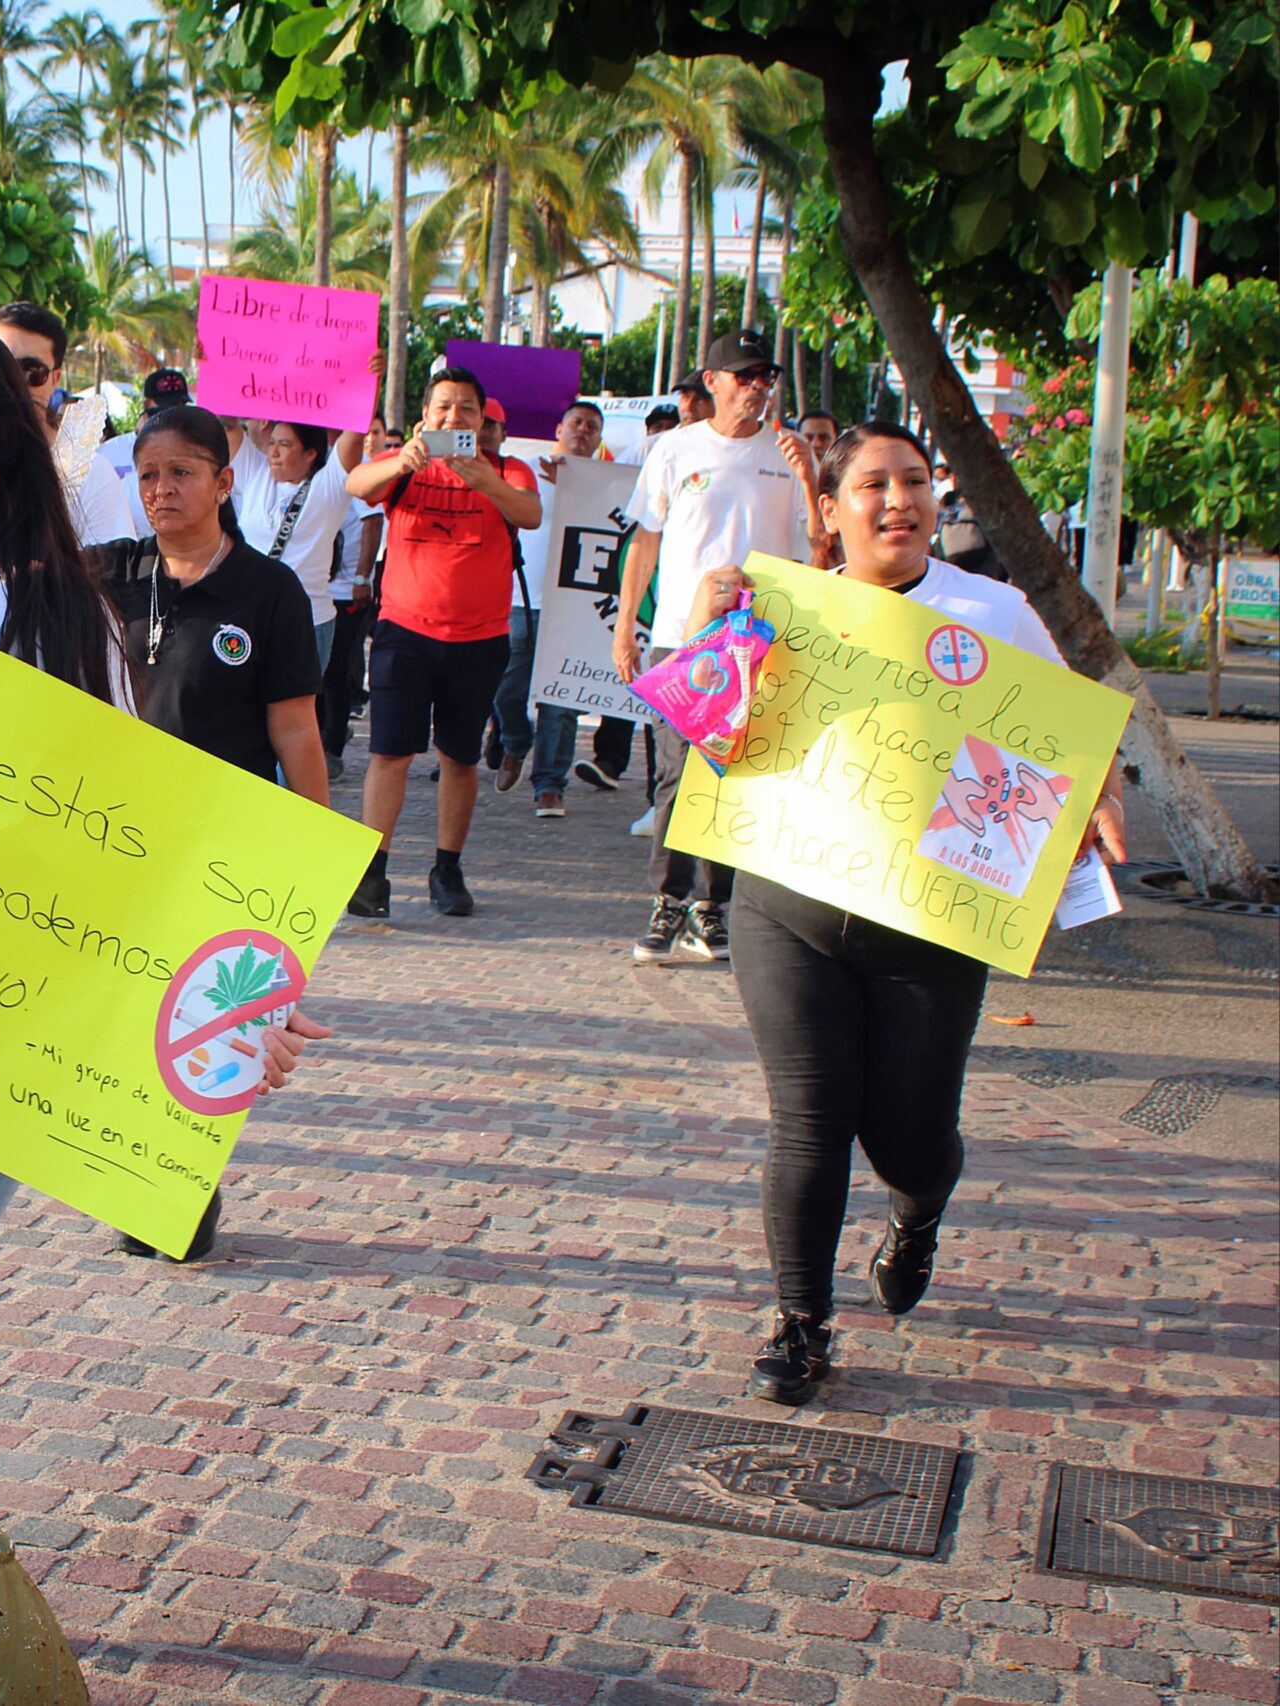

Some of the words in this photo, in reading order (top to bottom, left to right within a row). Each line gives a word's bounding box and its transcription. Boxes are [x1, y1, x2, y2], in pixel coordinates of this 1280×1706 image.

[289, 292, 310, 323] de
[315, 297, 368, 342] drogas
[295, 340, 314, 369] de
[628, 399, 650, 411] en
[1235, 573, 1275, 587] OBRA
[542, 680, 571, 700] de
[574, 686, 615, 710] Las
[756, 590, 871, 671] Decir
[875, 657, 935, 698] no
[937, 690, 963, 719] a
[976, 683, 1065, 763] las
[856, 697, 954, 774] hace
[842, 752, 915, 823] te
[686, 775, 758, 845] te
[774, 800, 874, 888] hace
[969, 842, 993, 861] ALTO
[938, 846, 948, 860] A
[948, 850, 970, 869] LAS
[969, 860, 1012, 888] DROGAS
[74, 1062, 121, 1094] grupo
[131, 1086, 150, 1105] de
[164, 1099, 223, 1145] Vallarta
[65, 1108, 92, 1132] luz
[100, 1126, 125, 1147] en
[130, 1141, 149, 1159] el
[155, 1151, 213, 1192] camino
